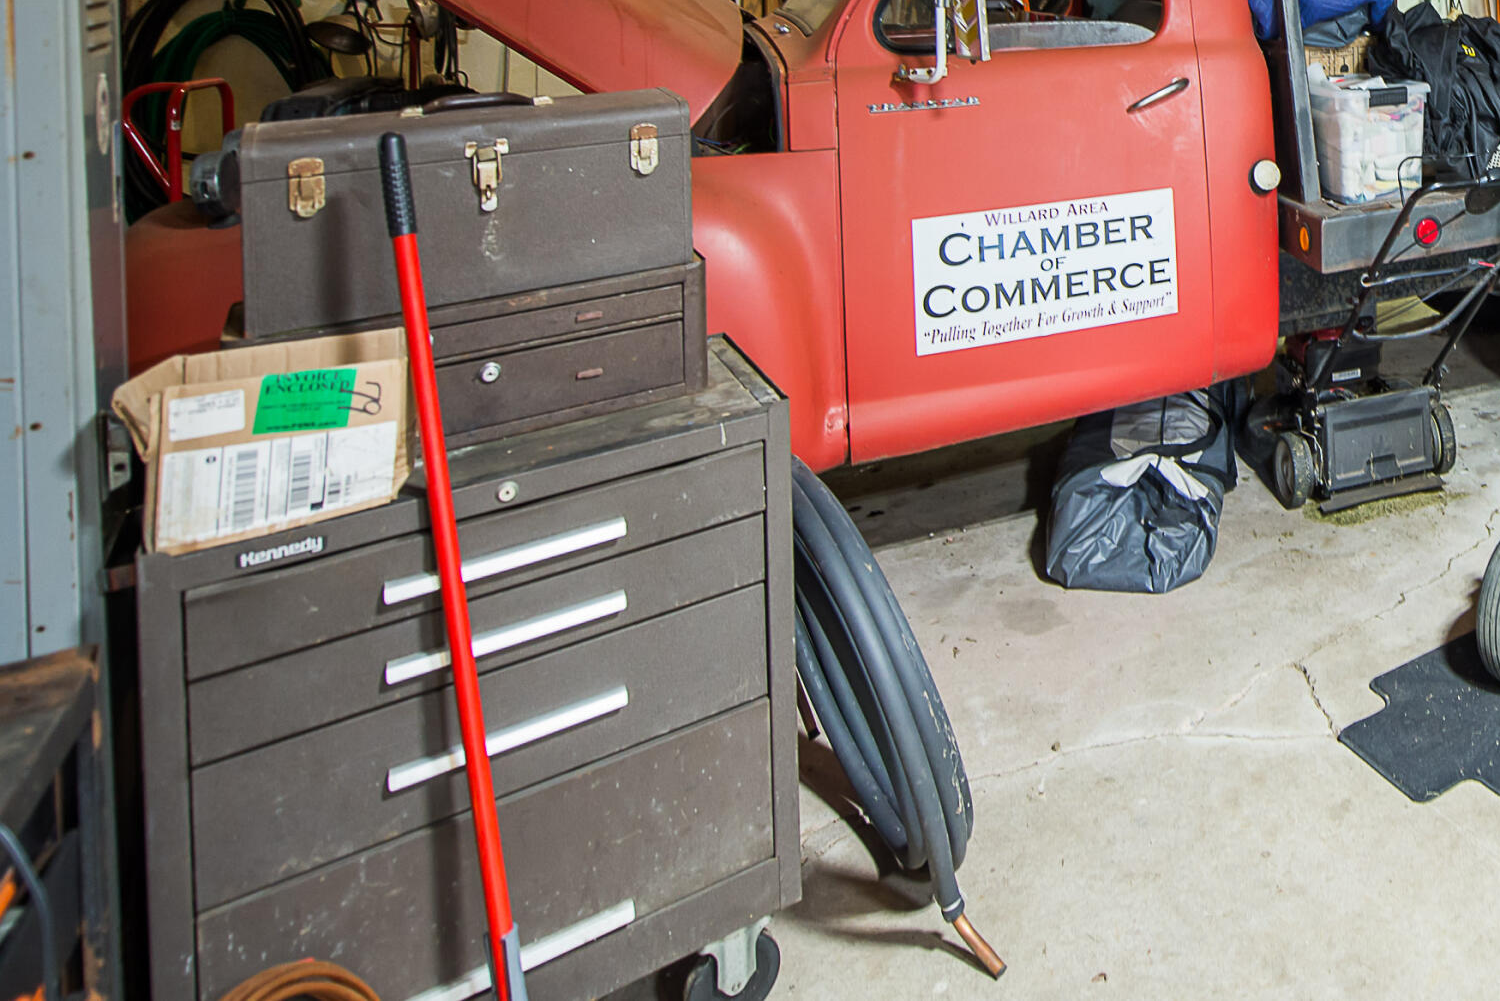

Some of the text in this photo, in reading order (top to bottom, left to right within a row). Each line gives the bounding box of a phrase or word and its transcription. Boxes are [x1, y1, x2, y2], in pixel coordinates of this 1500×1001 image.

[984, 201, 1109, 228] WILLARD AREA
[939, 214, 1154, 267] CHAMBER
[1040, 256, 1068, 272] OF
[923, 257, 1172, 319] COMMERCE
[981, 314, 1033, 338] Together
[1037, 311, 1058, 328] For
[1061, 302, 1104, 325] Growth
[1107, 299, 1117, 316] &
[265, 378, 350, 396] ENCLOSED
[275, 369, 341, 385] INVOICE
[239, 536, 323, 569] Kennedy
